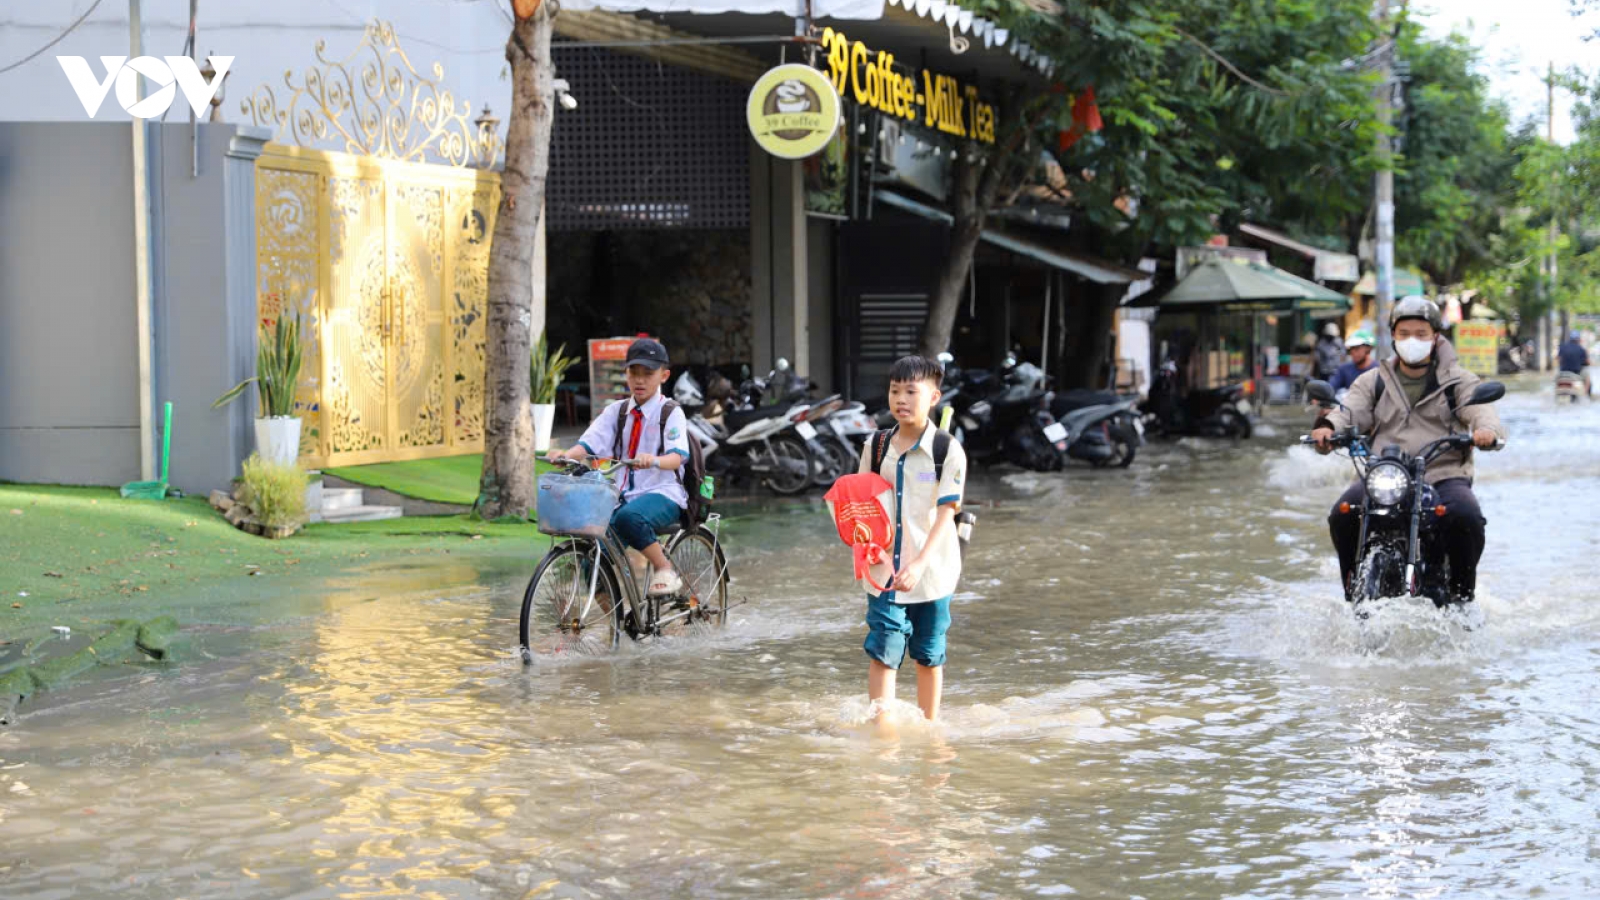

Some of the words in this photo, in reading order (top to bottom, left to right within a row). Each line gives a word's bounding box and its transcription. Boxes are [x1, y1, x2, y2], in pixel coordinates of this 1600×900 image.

[822, 26, 849, 97] 39
[965, 85, 995, 144] Tea
[782, 115, 820, 127] Coffee
